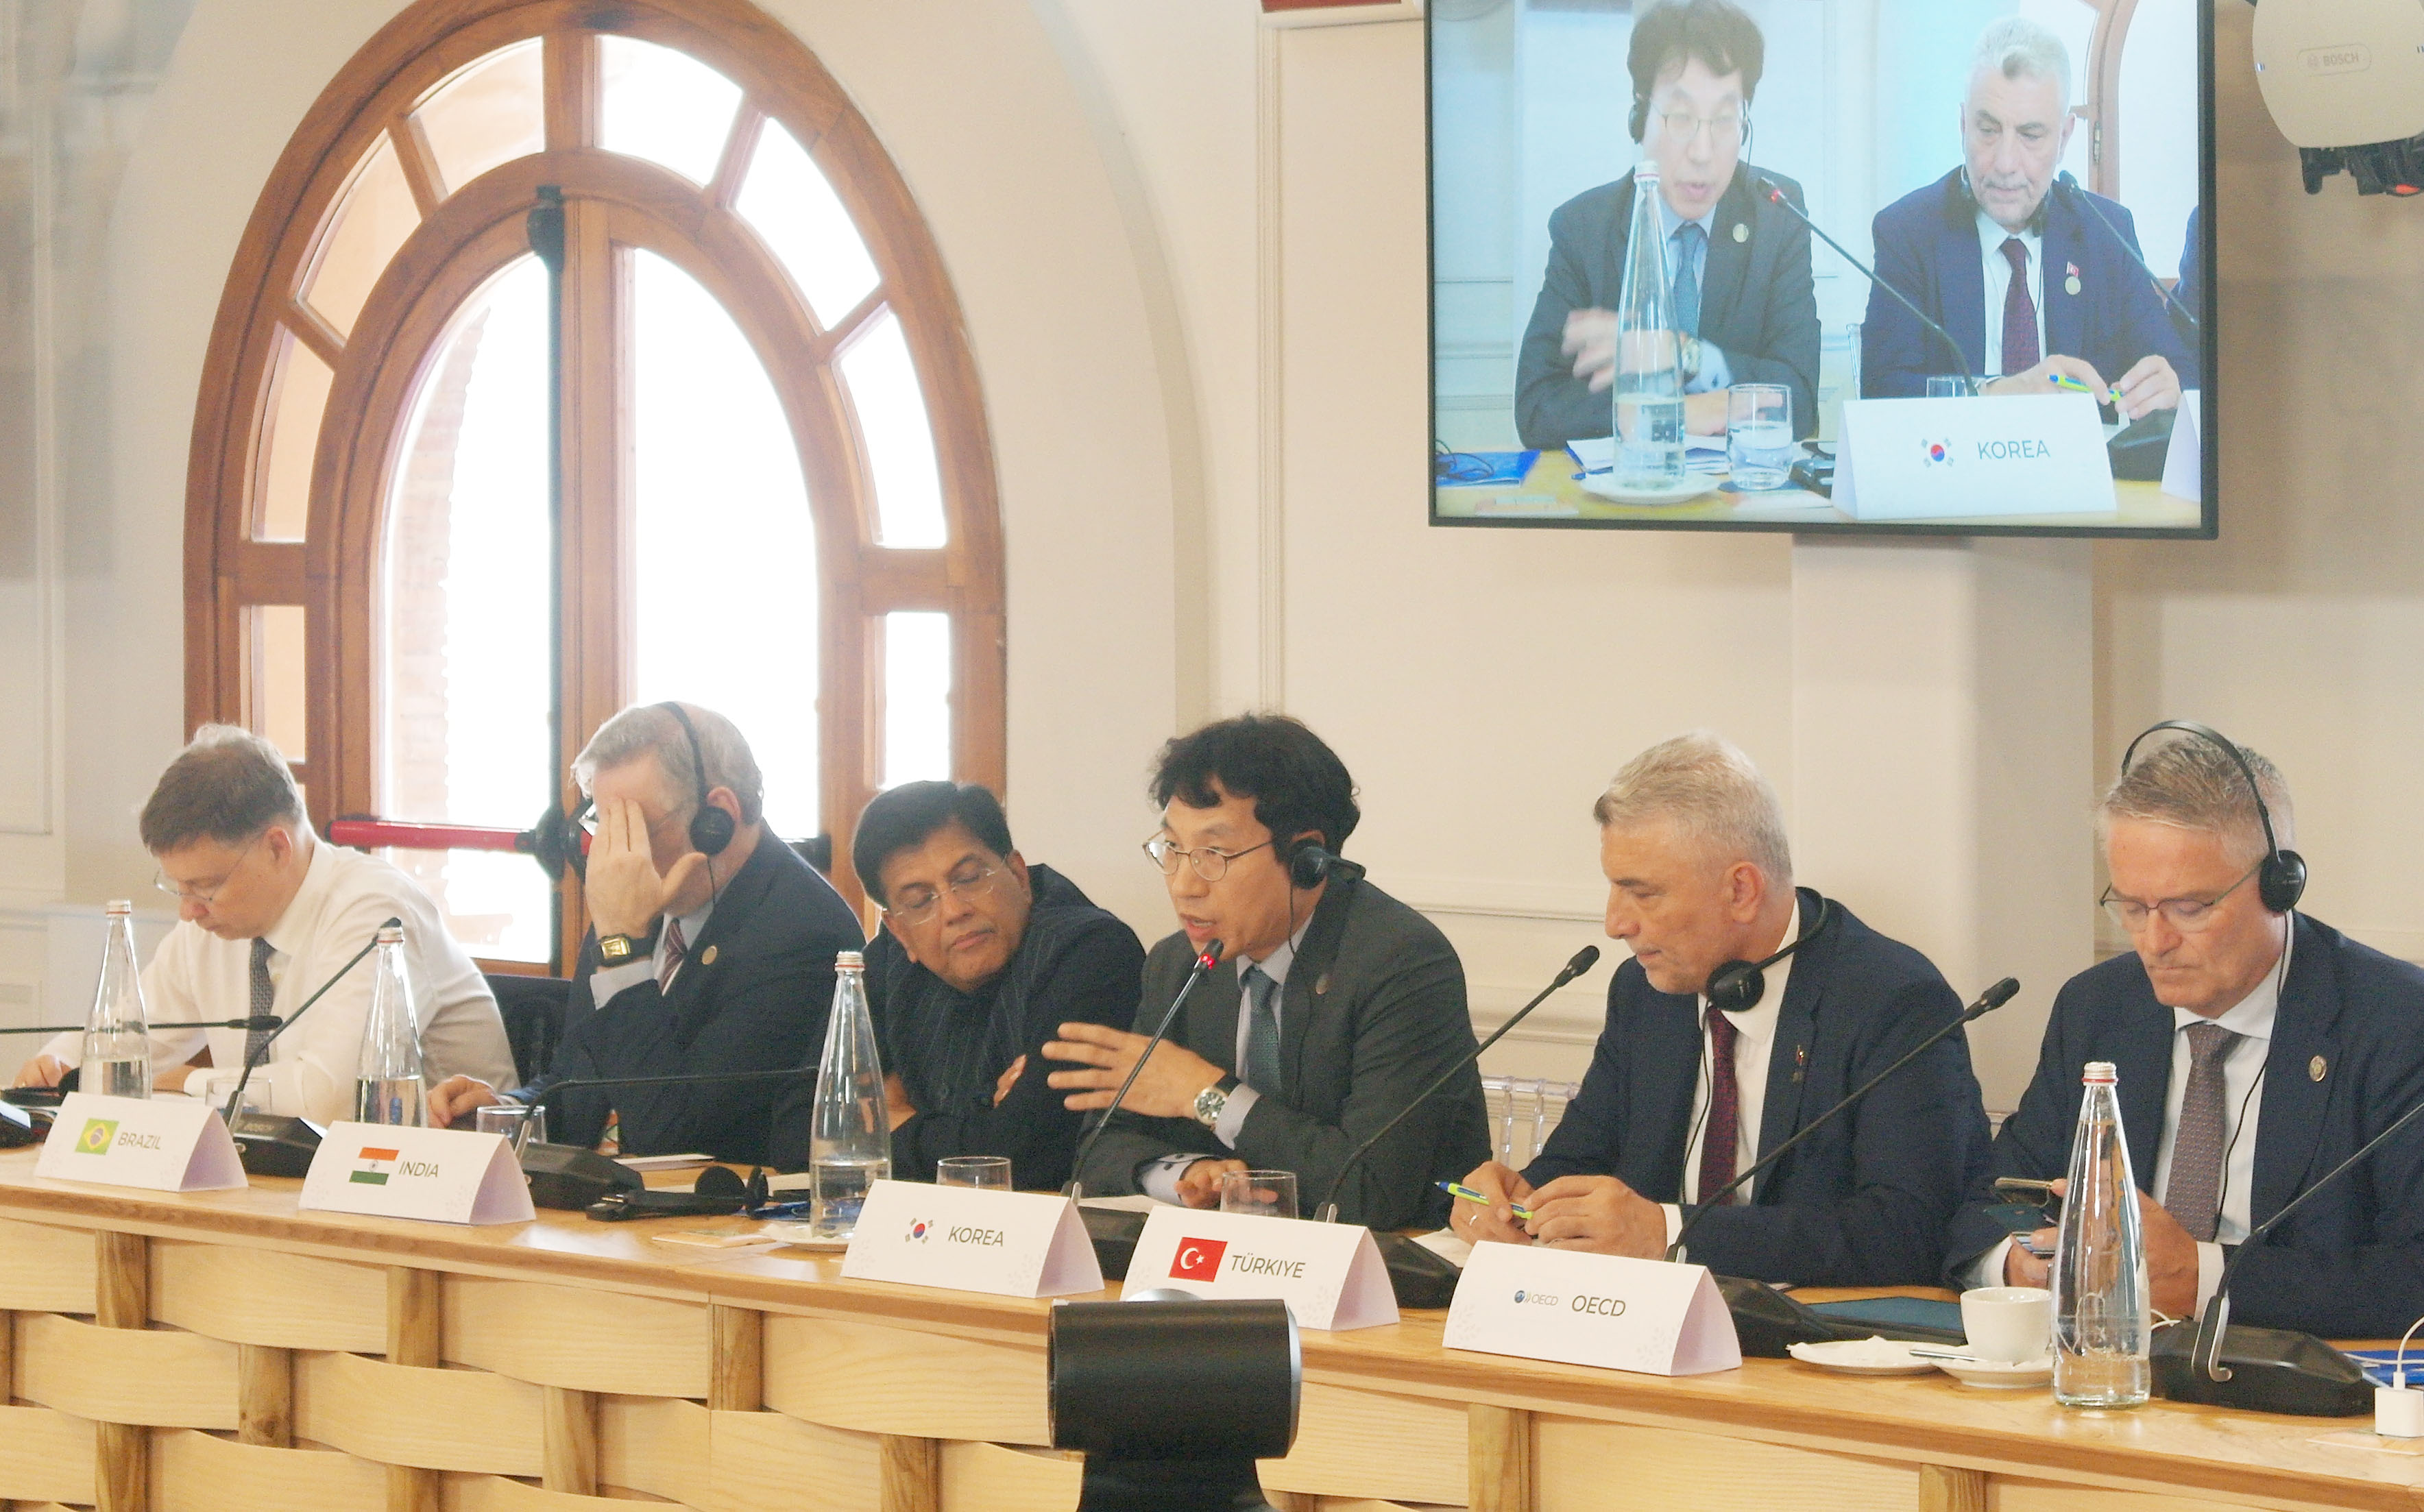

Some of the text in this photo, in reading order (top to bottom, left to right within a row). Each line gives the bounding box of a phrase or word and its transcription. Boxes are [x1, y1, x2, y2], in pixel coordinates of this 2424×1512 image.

[2323, 53, 2359, 66] BOSCH
[1977, 440, 2050, 459] KOREA
[118, 1132, 161, 1150] BRAZIL
[398, 1160, 439, 1178] INDIA
[947, 1226, 1004, 1247] KOREA
[1231, 1252, 1306, 1279] TÜRKIYE
[1531, 1293, 1627, 1317] OECD OECD
